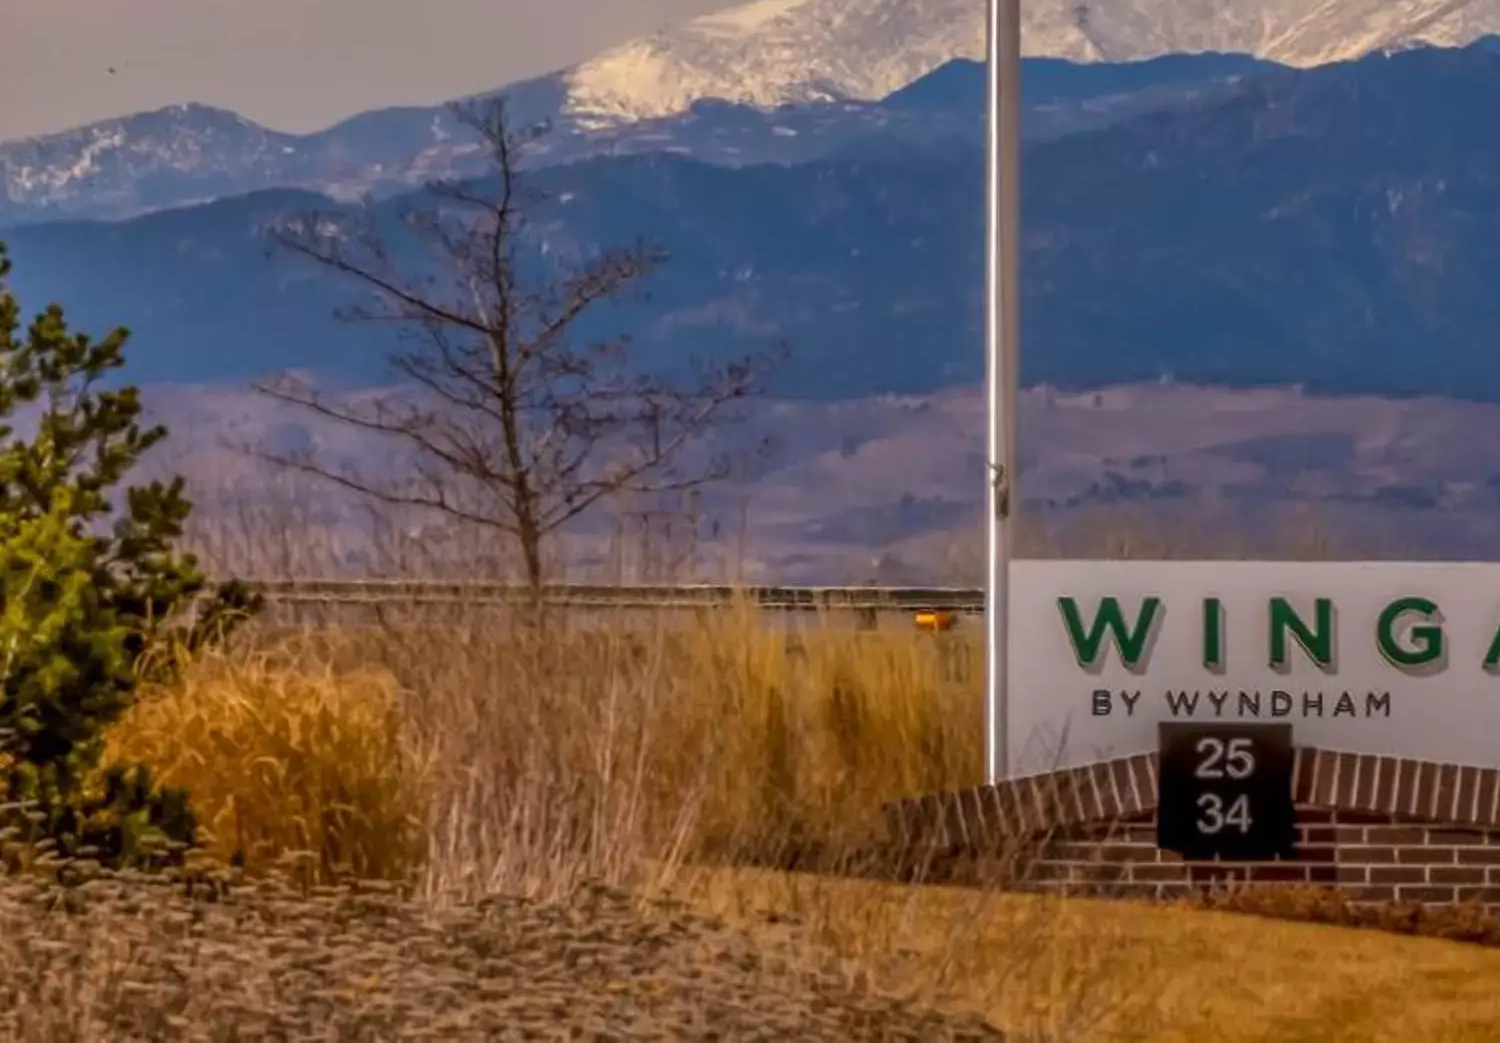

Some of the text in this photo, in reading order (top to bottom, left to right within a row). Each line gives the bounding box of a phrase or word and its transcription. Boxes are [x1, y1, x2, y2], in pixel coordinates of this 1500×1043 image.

[1091, 690, 1392, 718] BY WYNDHAM
[1195, 738, 1255, 779] 25
[1196, 794, 1253, 834] 34
